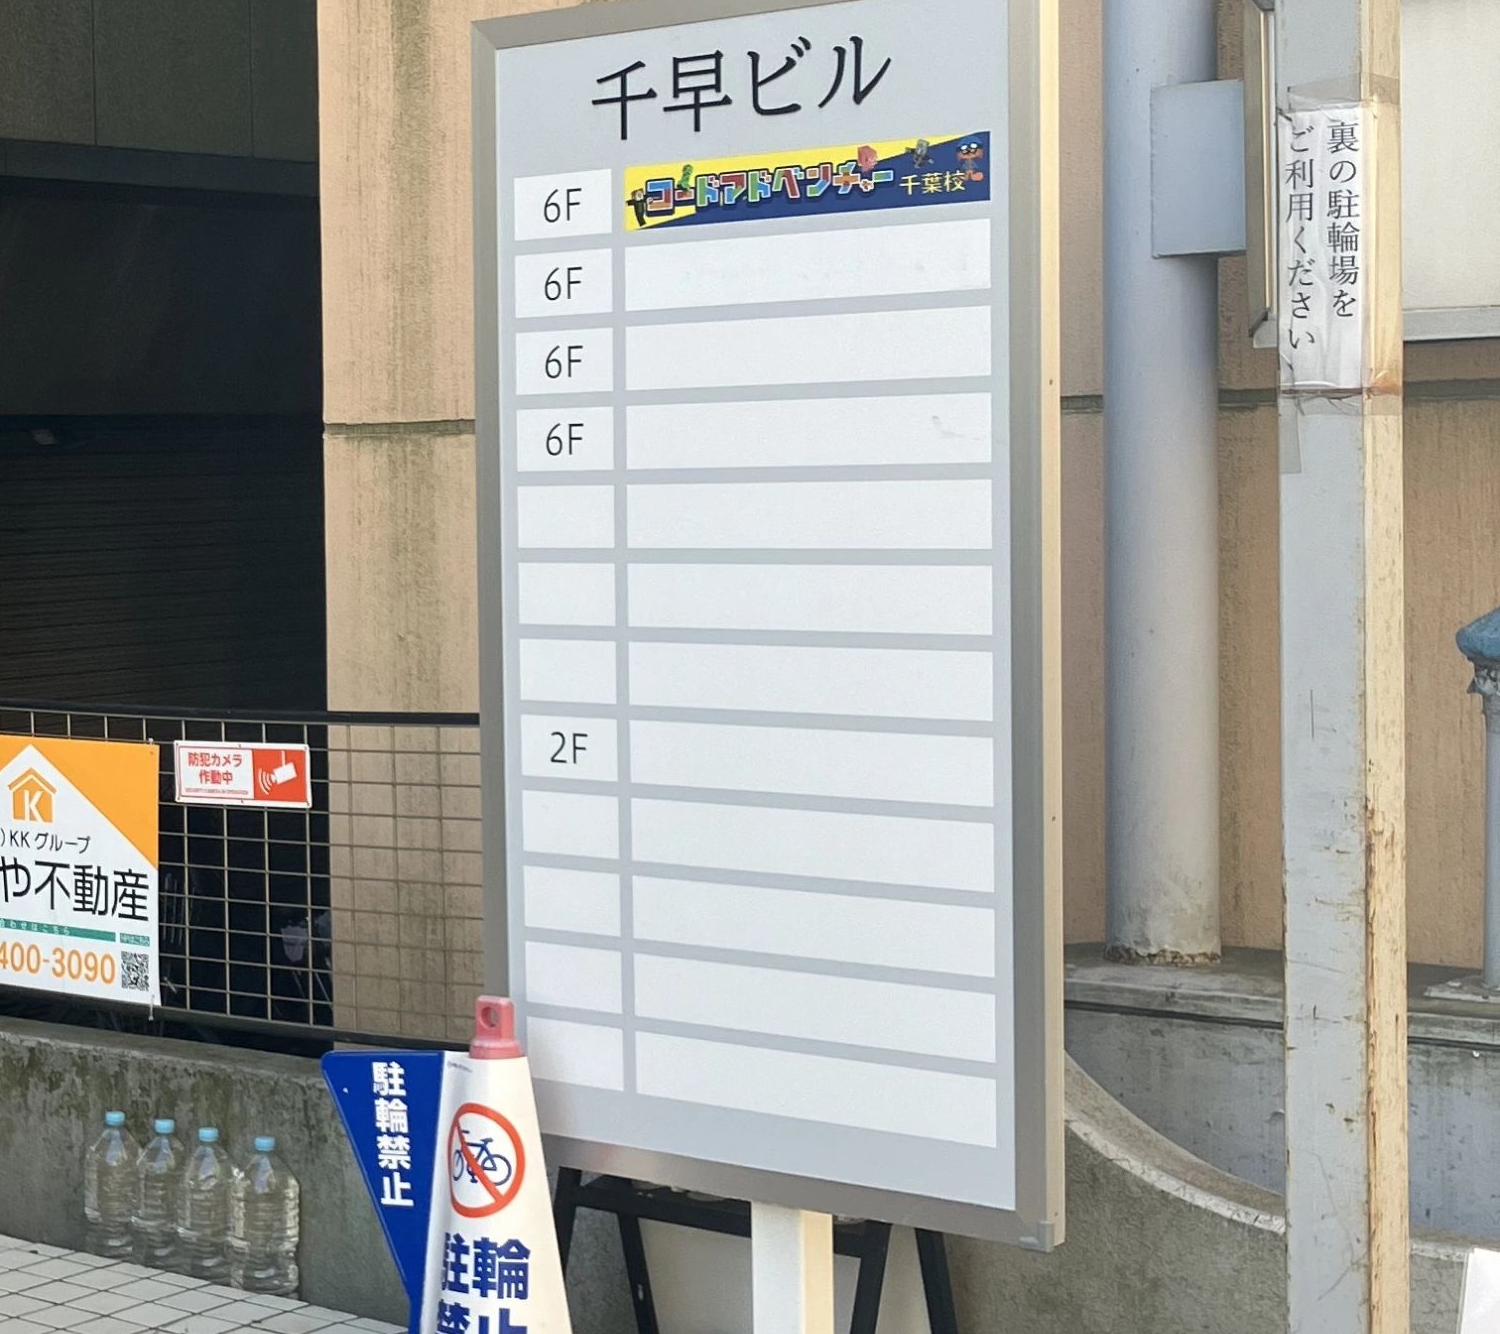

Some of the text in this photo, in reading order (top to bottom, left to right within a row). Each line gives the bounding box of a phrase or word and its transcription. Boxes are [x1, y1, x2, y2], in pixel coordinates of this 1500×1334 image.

[591, 35, 892, 141] 千早ビル
[543, 188, 583, 223] 6F
[646, 162, 966, 214] コードアドベンチャー 千葉校
[1285, 125, 1315, 349] ご利用ください
[1327, 122, 1360, 317] 裏の駐輪場を
[543, 266, 583, 302] 6F
[545, 345, 584, 380] 6F
[546, 422, 584, 457] 6F
[187, 752, 242, 767] 防犯カメラ
[550, 731, 588, 764] 2F
[199, 769, 233, 785] 作動中
[372, 1061, 414, 1207] 駐輪禁止
